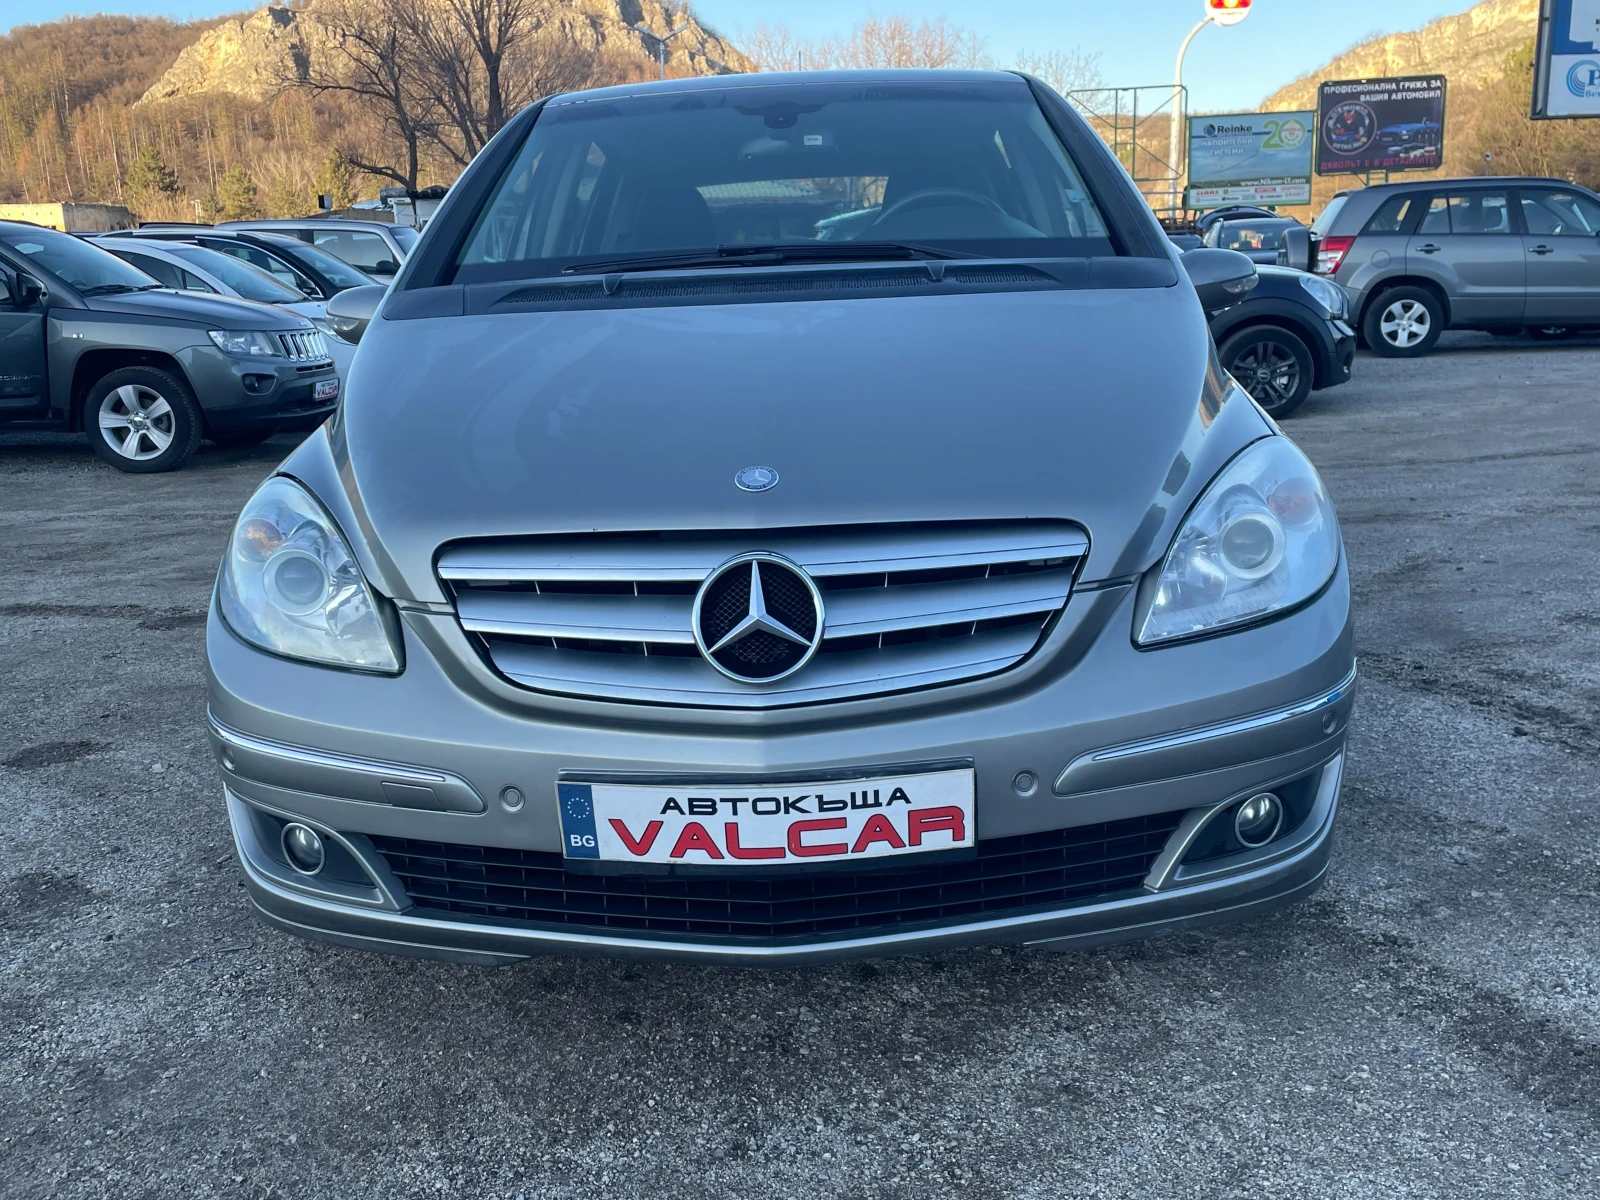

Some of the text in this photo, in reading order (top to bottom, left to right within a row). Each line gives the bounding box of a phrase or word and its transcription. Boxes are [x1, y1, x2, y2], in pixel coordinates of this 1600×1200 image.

[1400, 80, 1428, 90] ГРИЖА
[1430, 79, 1442, 88] ЗА
[1360, 89, 1441, 102] ВАШИЯ АВТОМОБИЛ
[1217, 124, 1253, 134] Reinke
[1209, 148, 1244, 156] СИСТЕМИ
[660, 787, 912, 816] АВТОКЪЩА
[607, 805, 966, 860] VALCAR
[570, 833, 596, 848] BG
